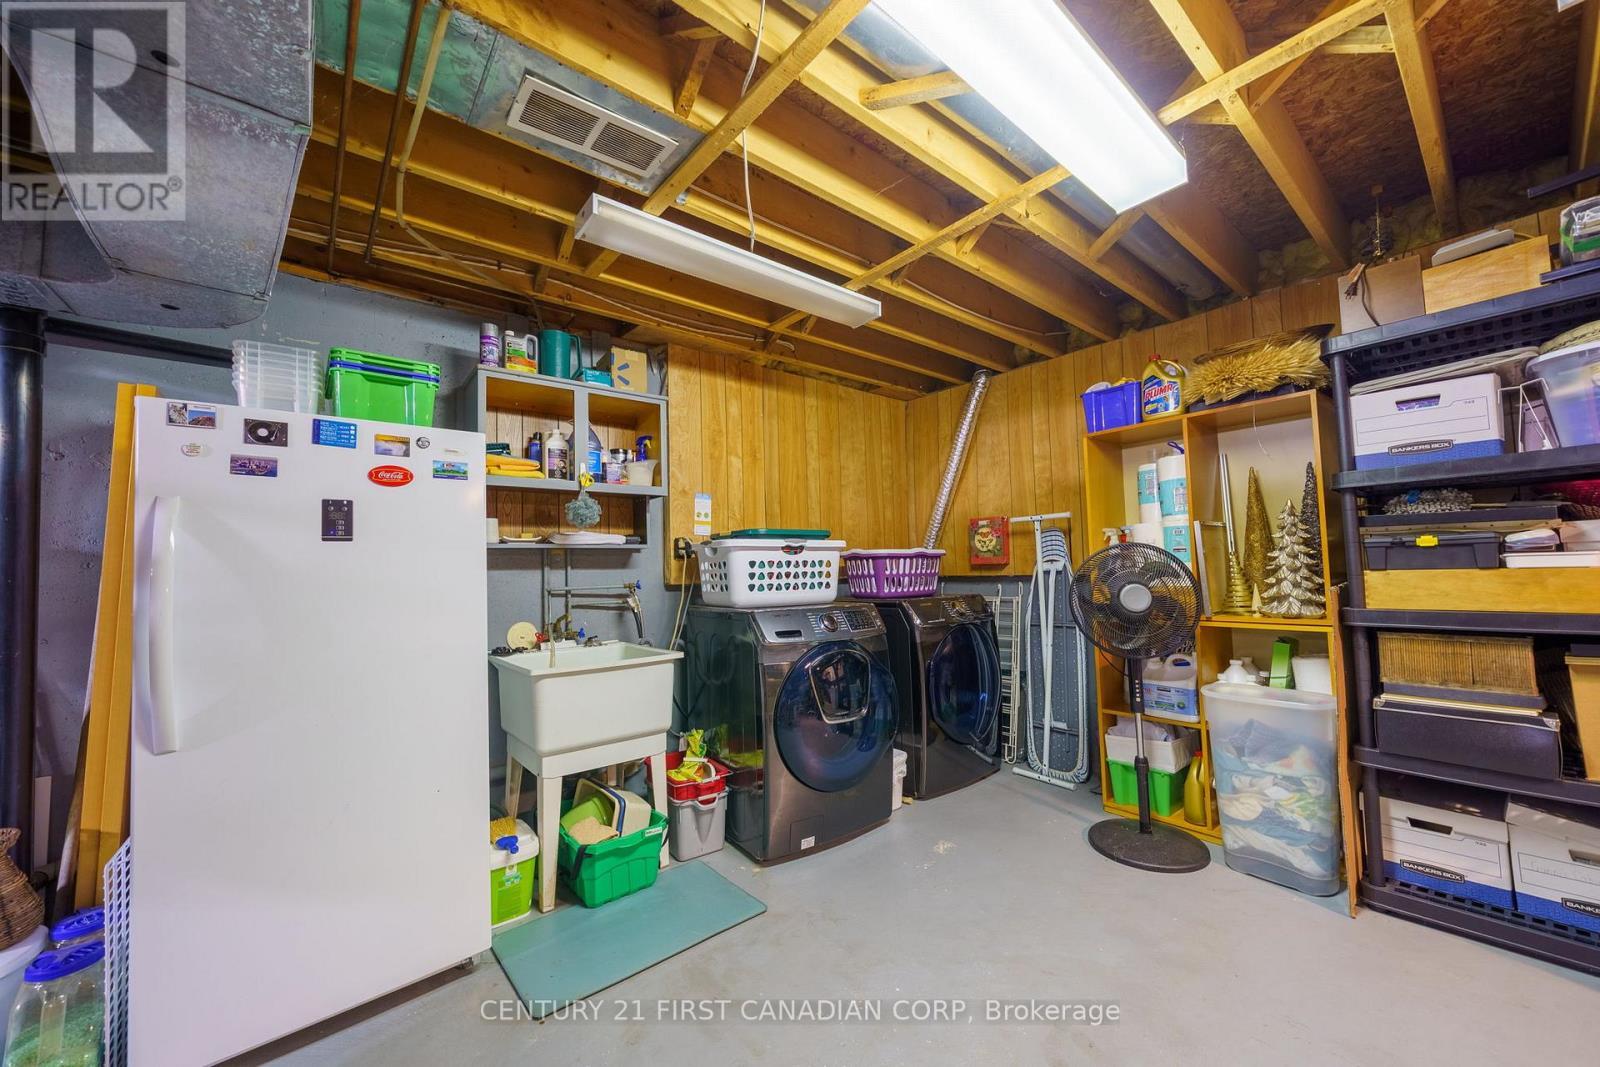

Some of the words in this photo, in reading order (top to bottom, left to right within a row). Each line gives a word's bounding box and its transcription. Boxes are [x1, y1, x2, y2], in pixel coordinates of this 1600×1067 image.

[1391, 444, 1431, 453] BANKERS
[1403, 862, 1442, 876] BANKERS
[1442, 872, 1462, 881] BOX
